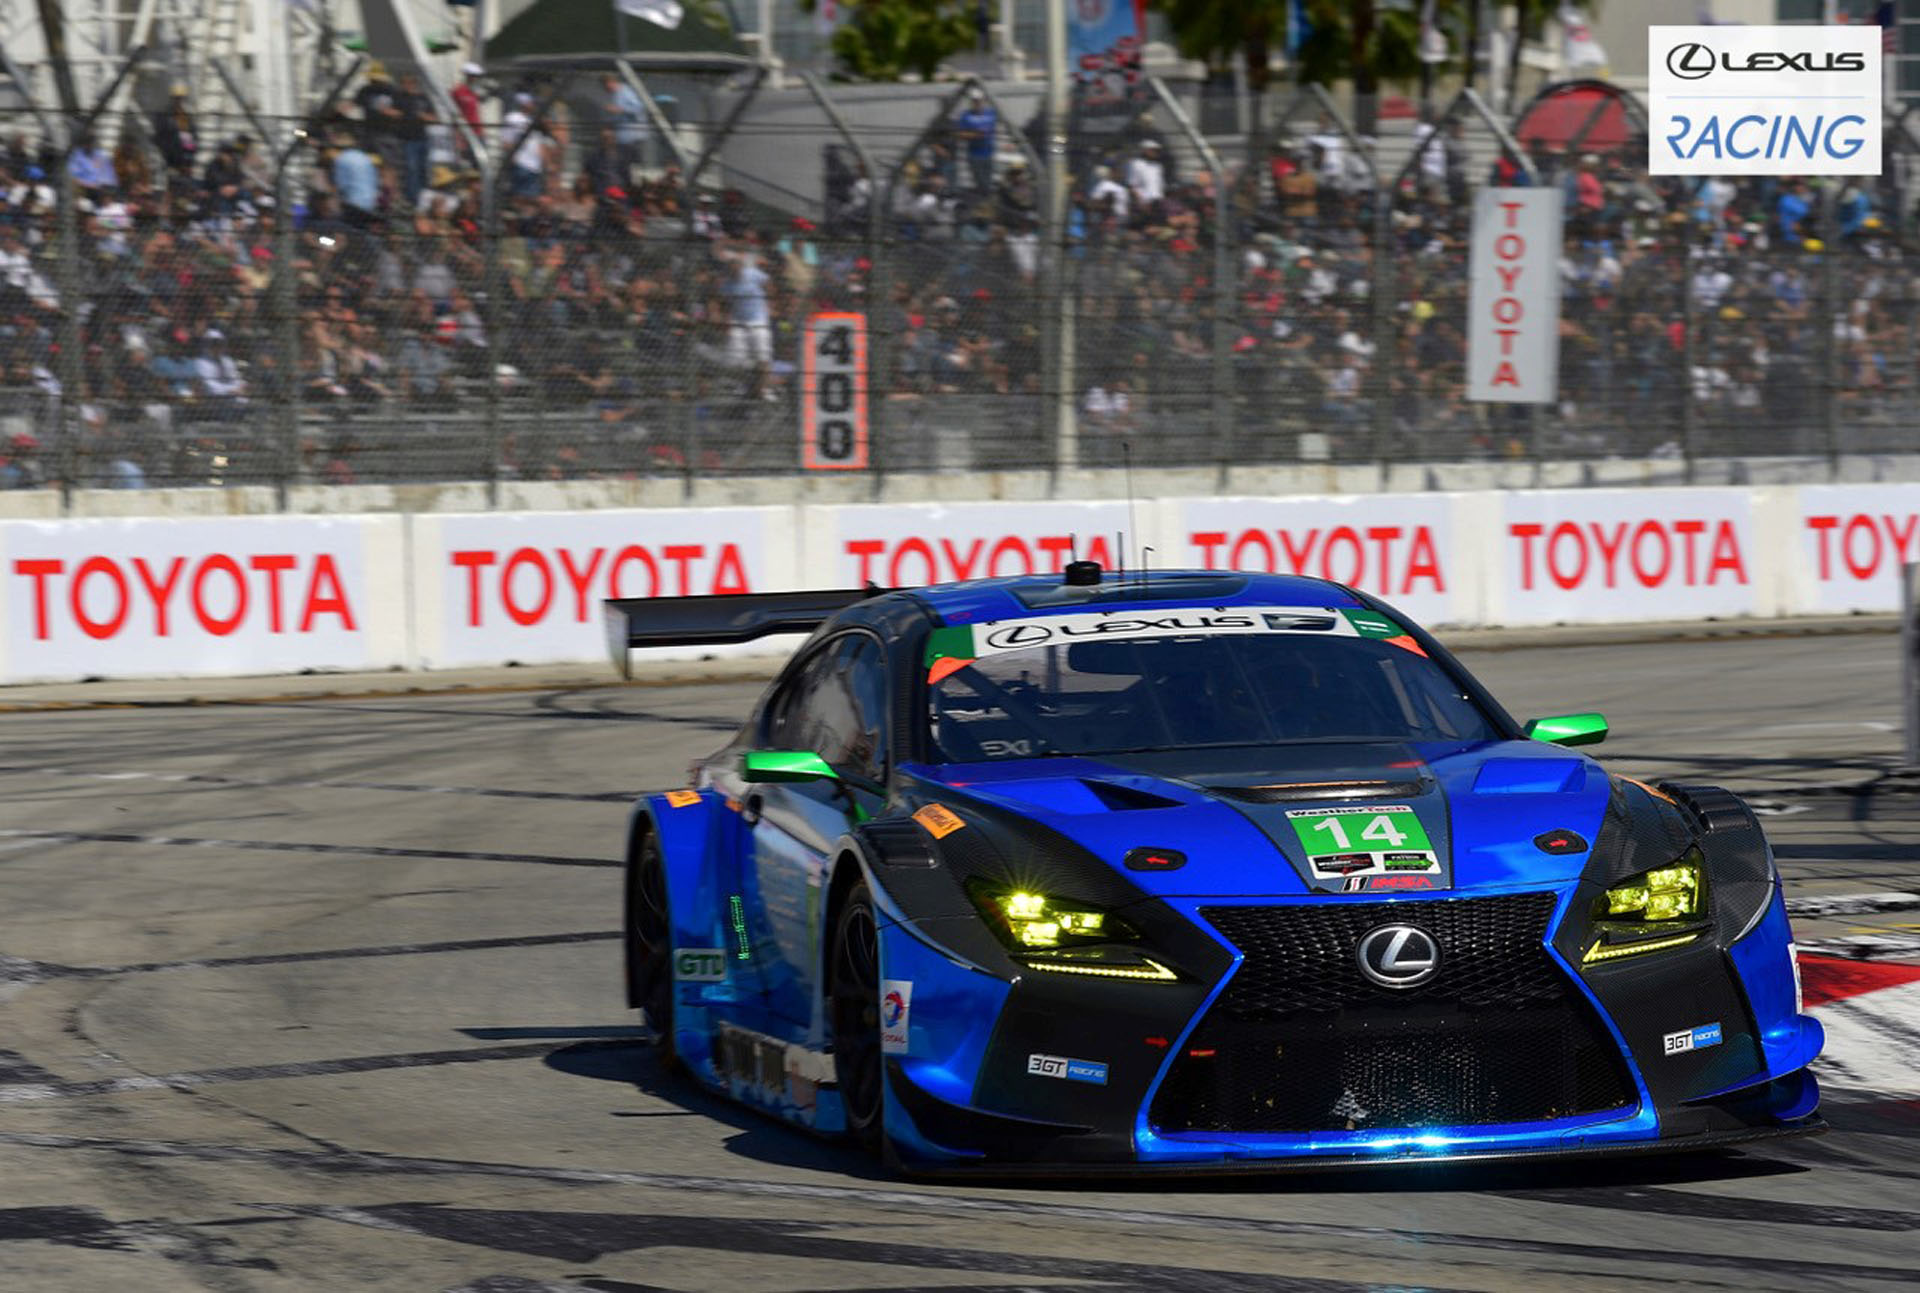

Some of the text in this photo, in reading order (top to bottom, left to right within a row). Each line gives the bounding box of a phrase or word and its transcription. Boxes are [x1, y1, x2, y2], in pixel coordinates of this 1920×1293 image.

[1490, 202, 1526, 387] TOYOTA
[819, 325, 854, 460] 400
[450, 543, 752, 627] TOYOTA
[1189, 525, 1446, 596] TOYOTA
[1508, 519, 1749, 591] TOYOTA
[13, 553, 358, 640] TOYOTA
[1060, 614, 1254, 636] LEXUS
[1313, 815, 1409, 849] 14
[1371, 876, 1434, 888] IMSA
[1030, 1057, 1066, 1075] 3GT
[1667, 1033, 1692, 1050] 3GT
